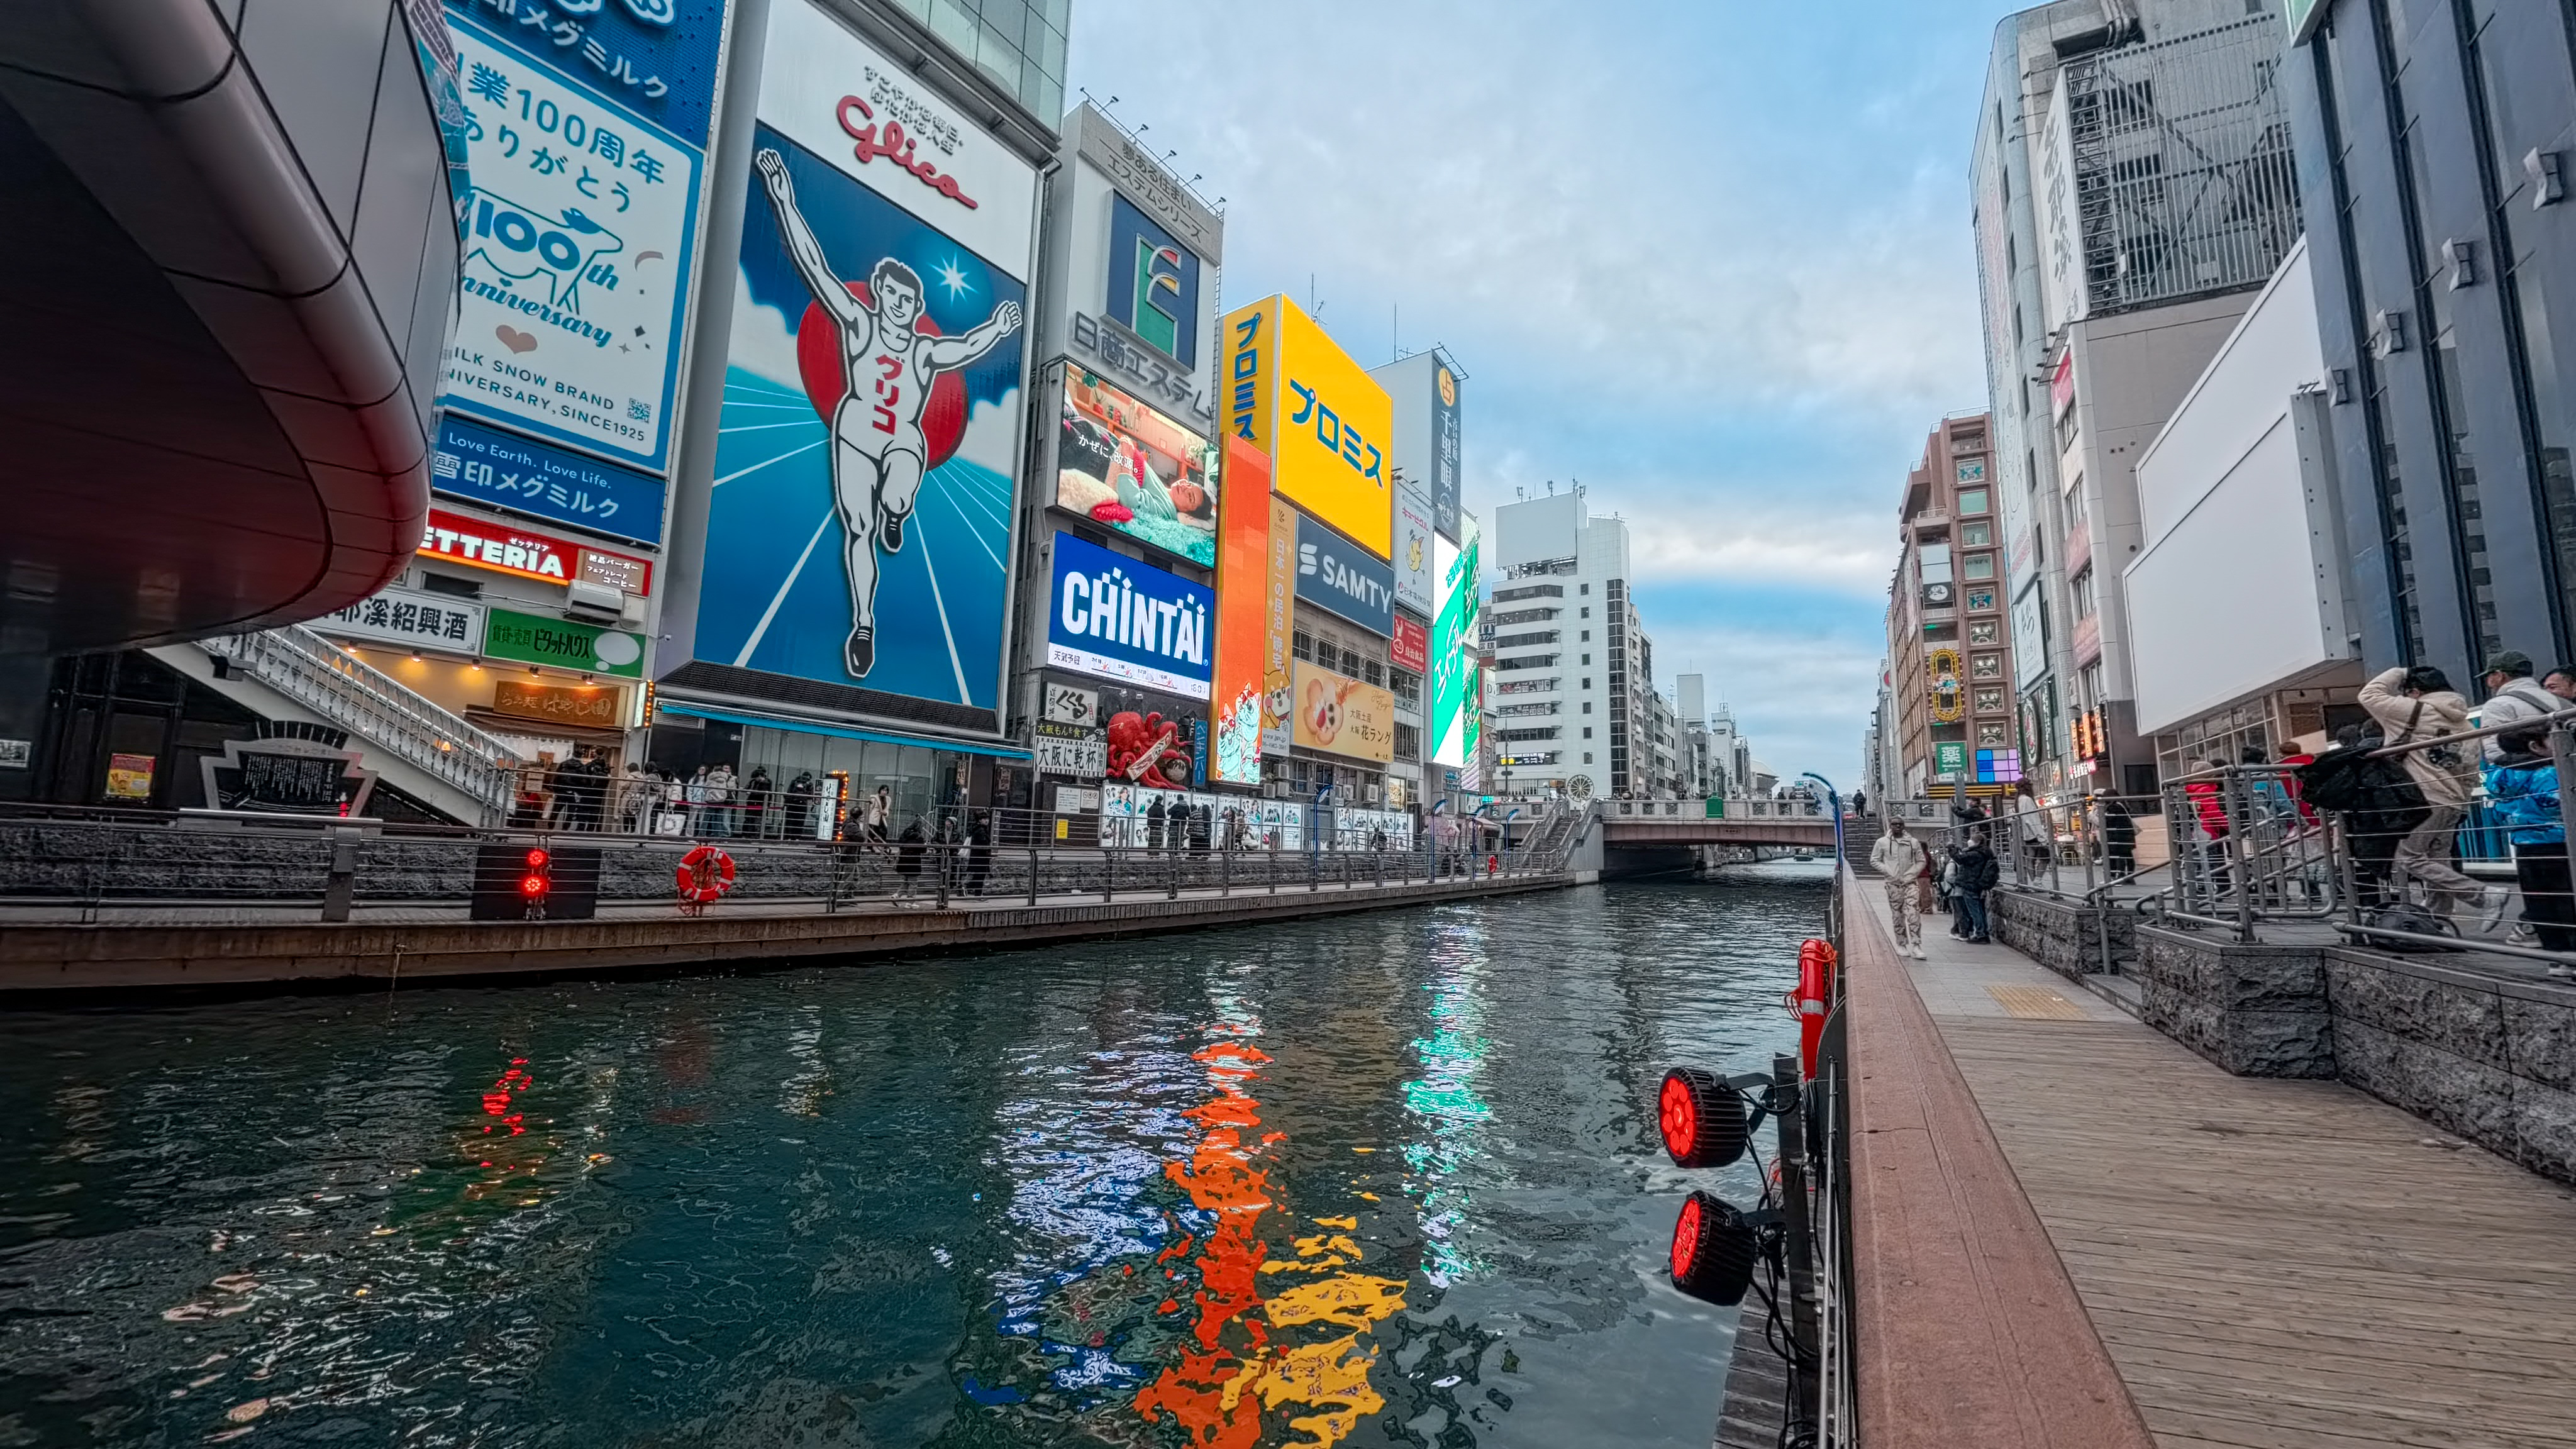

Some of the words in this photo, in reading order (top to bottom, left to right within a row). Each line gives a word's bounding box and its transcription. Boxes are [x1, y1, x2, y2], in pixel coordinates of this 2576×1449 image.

[457, 52, 664, 184] 業100周年
[837, 95, 979, 209] Glico
[1122, 141, 1191, 211] 夢ある住まい
[1108, 154, 1202, 243] エステムシリーズ
[475, 199, 580, 271] 100
[586, 264, 619, 291] th
[493, 360, 548, 387] SNOW
[555, 382, 615, 411] BRAND
[872, 354, 906, 436] グリコ
[1233, 312, 1262, 440] プロミス
[449, 433, 485, 453] Love
[490, 445, 537, 467] Earth.
[545, 460, 578, 481] Love
[582, 470, 612, 489] Life.
[1078, 434, 1138, 474] かぜに、改源。
[1290, 378, 1384, 490] プロミス
[433, 452, 619, 518] 雪印メグミルク
[509, 536, 550, 552] ゼッテリア
[587, 565, 628, 579] フェアトレード
[589, 554, 639, 570] 絶品バーガー
[602, 577, 637, 587] コーヒー
[1323, 555, 1392, 614] SAMTY
[534, 628, 589, 658] ピタットハウス
[1037, 723, 1089, 738] 大阪もんを食す
[1056, 689, 1088, 719] くくる
[1038, 742, 1096, 770] 大阪に乾杯
